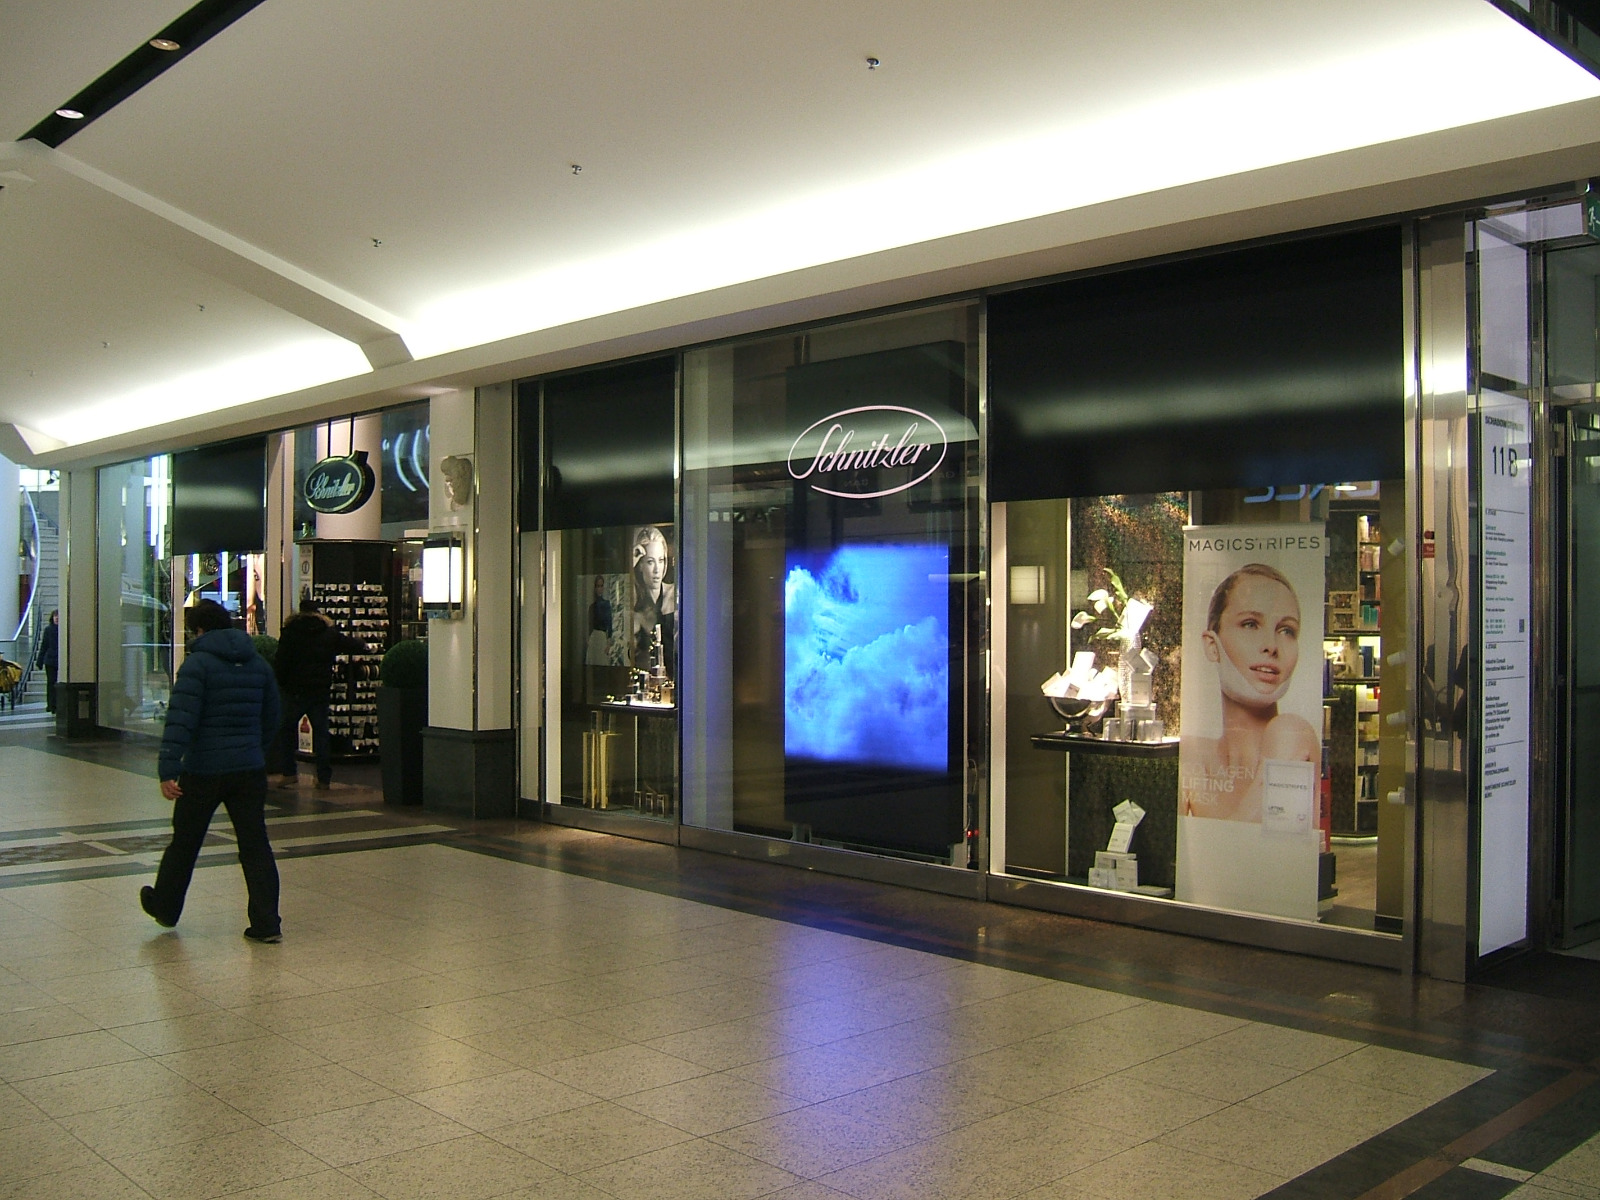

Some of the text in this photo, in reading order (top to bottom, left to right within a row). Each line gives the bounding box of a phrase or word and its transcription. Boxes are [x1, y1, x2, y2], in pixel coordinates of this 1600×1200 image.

[790, 422, 931, 480] Schnitzler
[1189, 536, 1321, 552] MAGICSTRIPES
[1182, 777, 1235, 793] LIFTING
